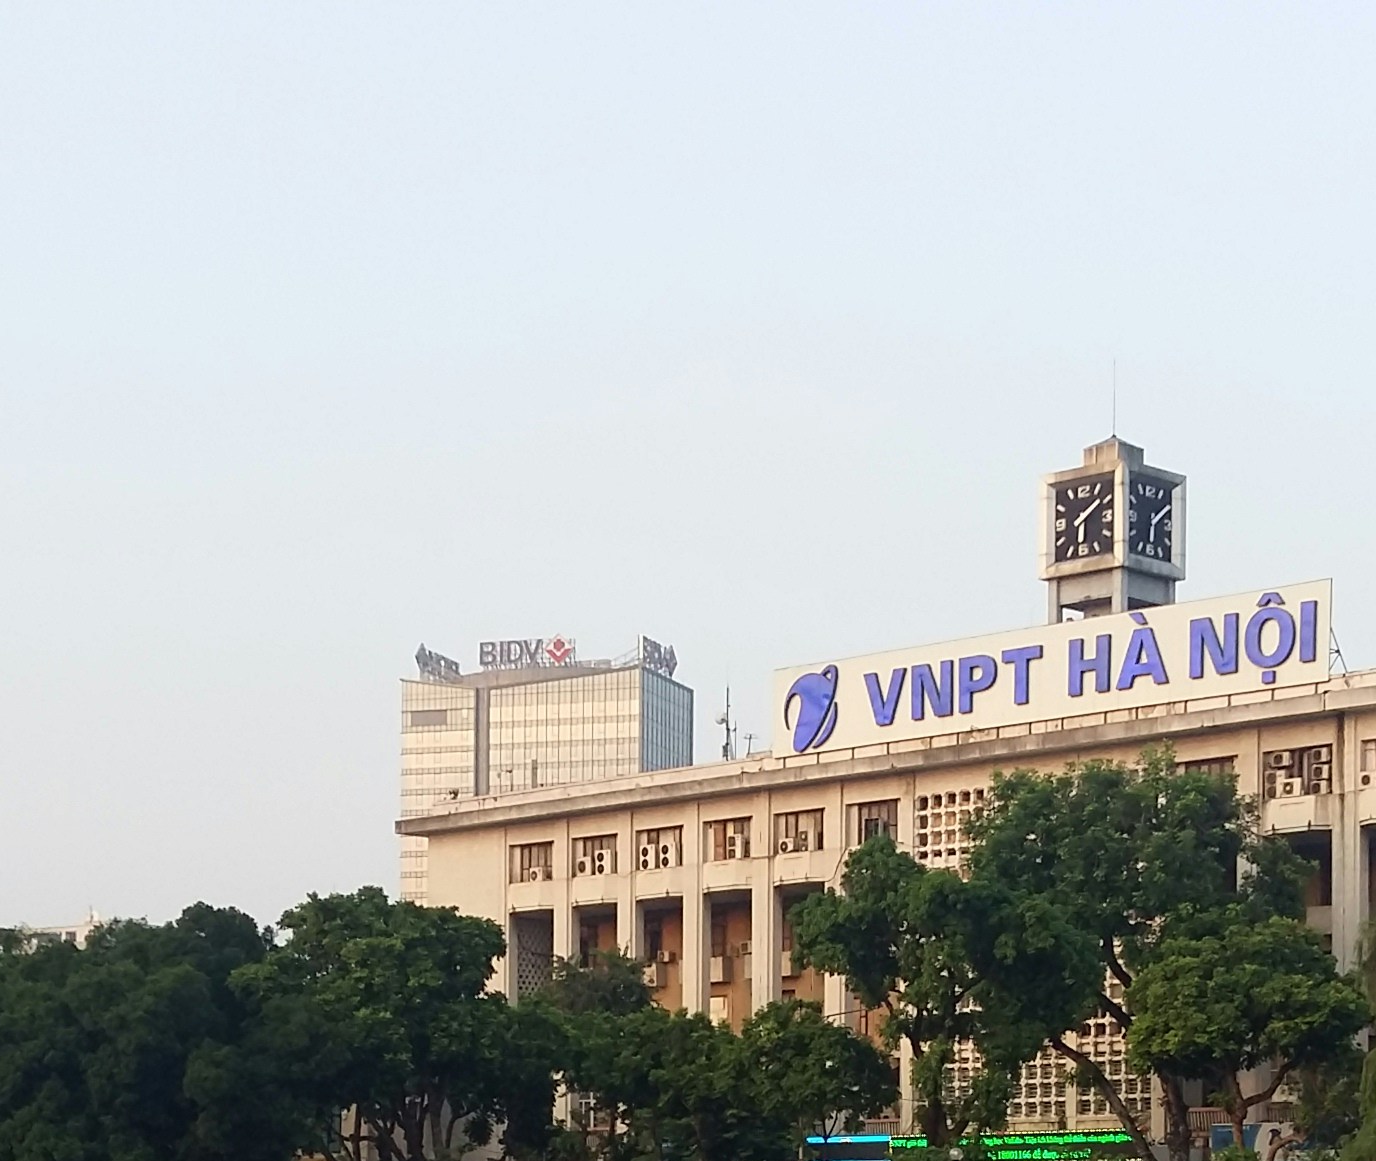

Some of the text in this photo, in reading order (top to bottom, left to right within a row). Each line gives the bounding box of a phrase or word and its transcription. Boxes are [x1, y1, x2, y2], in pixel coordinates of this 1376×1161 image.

[1056, 509, 1112, 531] 9 3
[1164, 519, 1172, 531] 3
[1078, 543, 1089, 556] 6
[1146, 543, 1155, 555] 6
[479, 639, 543, 665] BIDV
[863, 592, 1318, 728] VNPT HÀ NỘI
